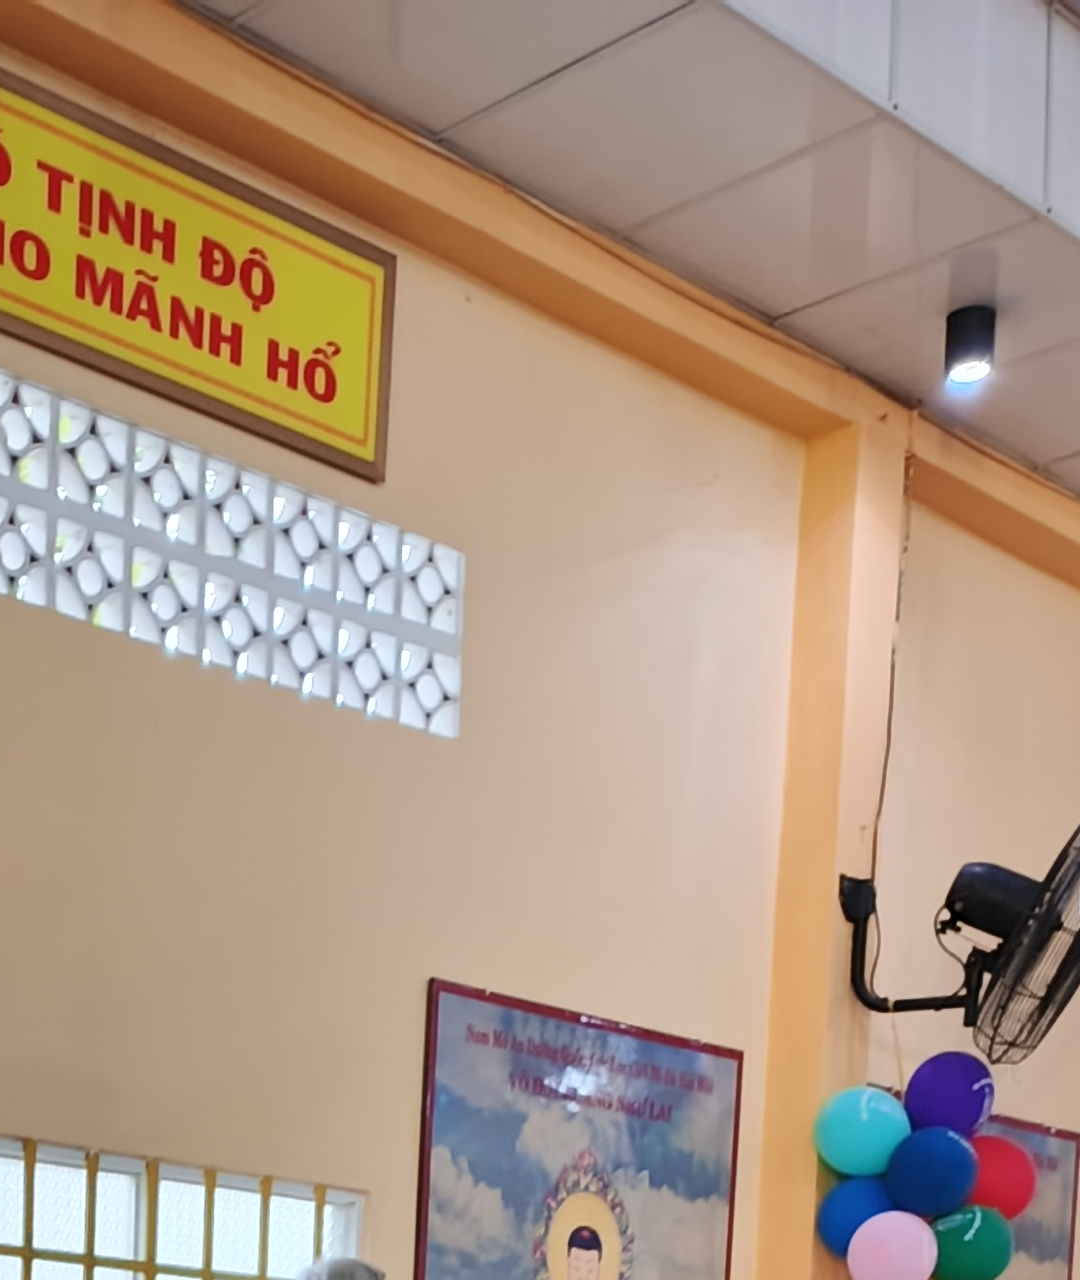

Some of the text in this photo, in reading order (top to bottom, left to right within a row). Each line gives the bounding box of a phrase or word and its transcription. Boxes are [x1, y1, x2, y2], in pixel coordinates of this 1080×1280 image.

[36, 160, 177, 265] TỊNH
[198, 236, 276, 313] ĐỘ
[74, 254, 244, 367] MÃNH
[266, 339, 341, 405] HỔ
